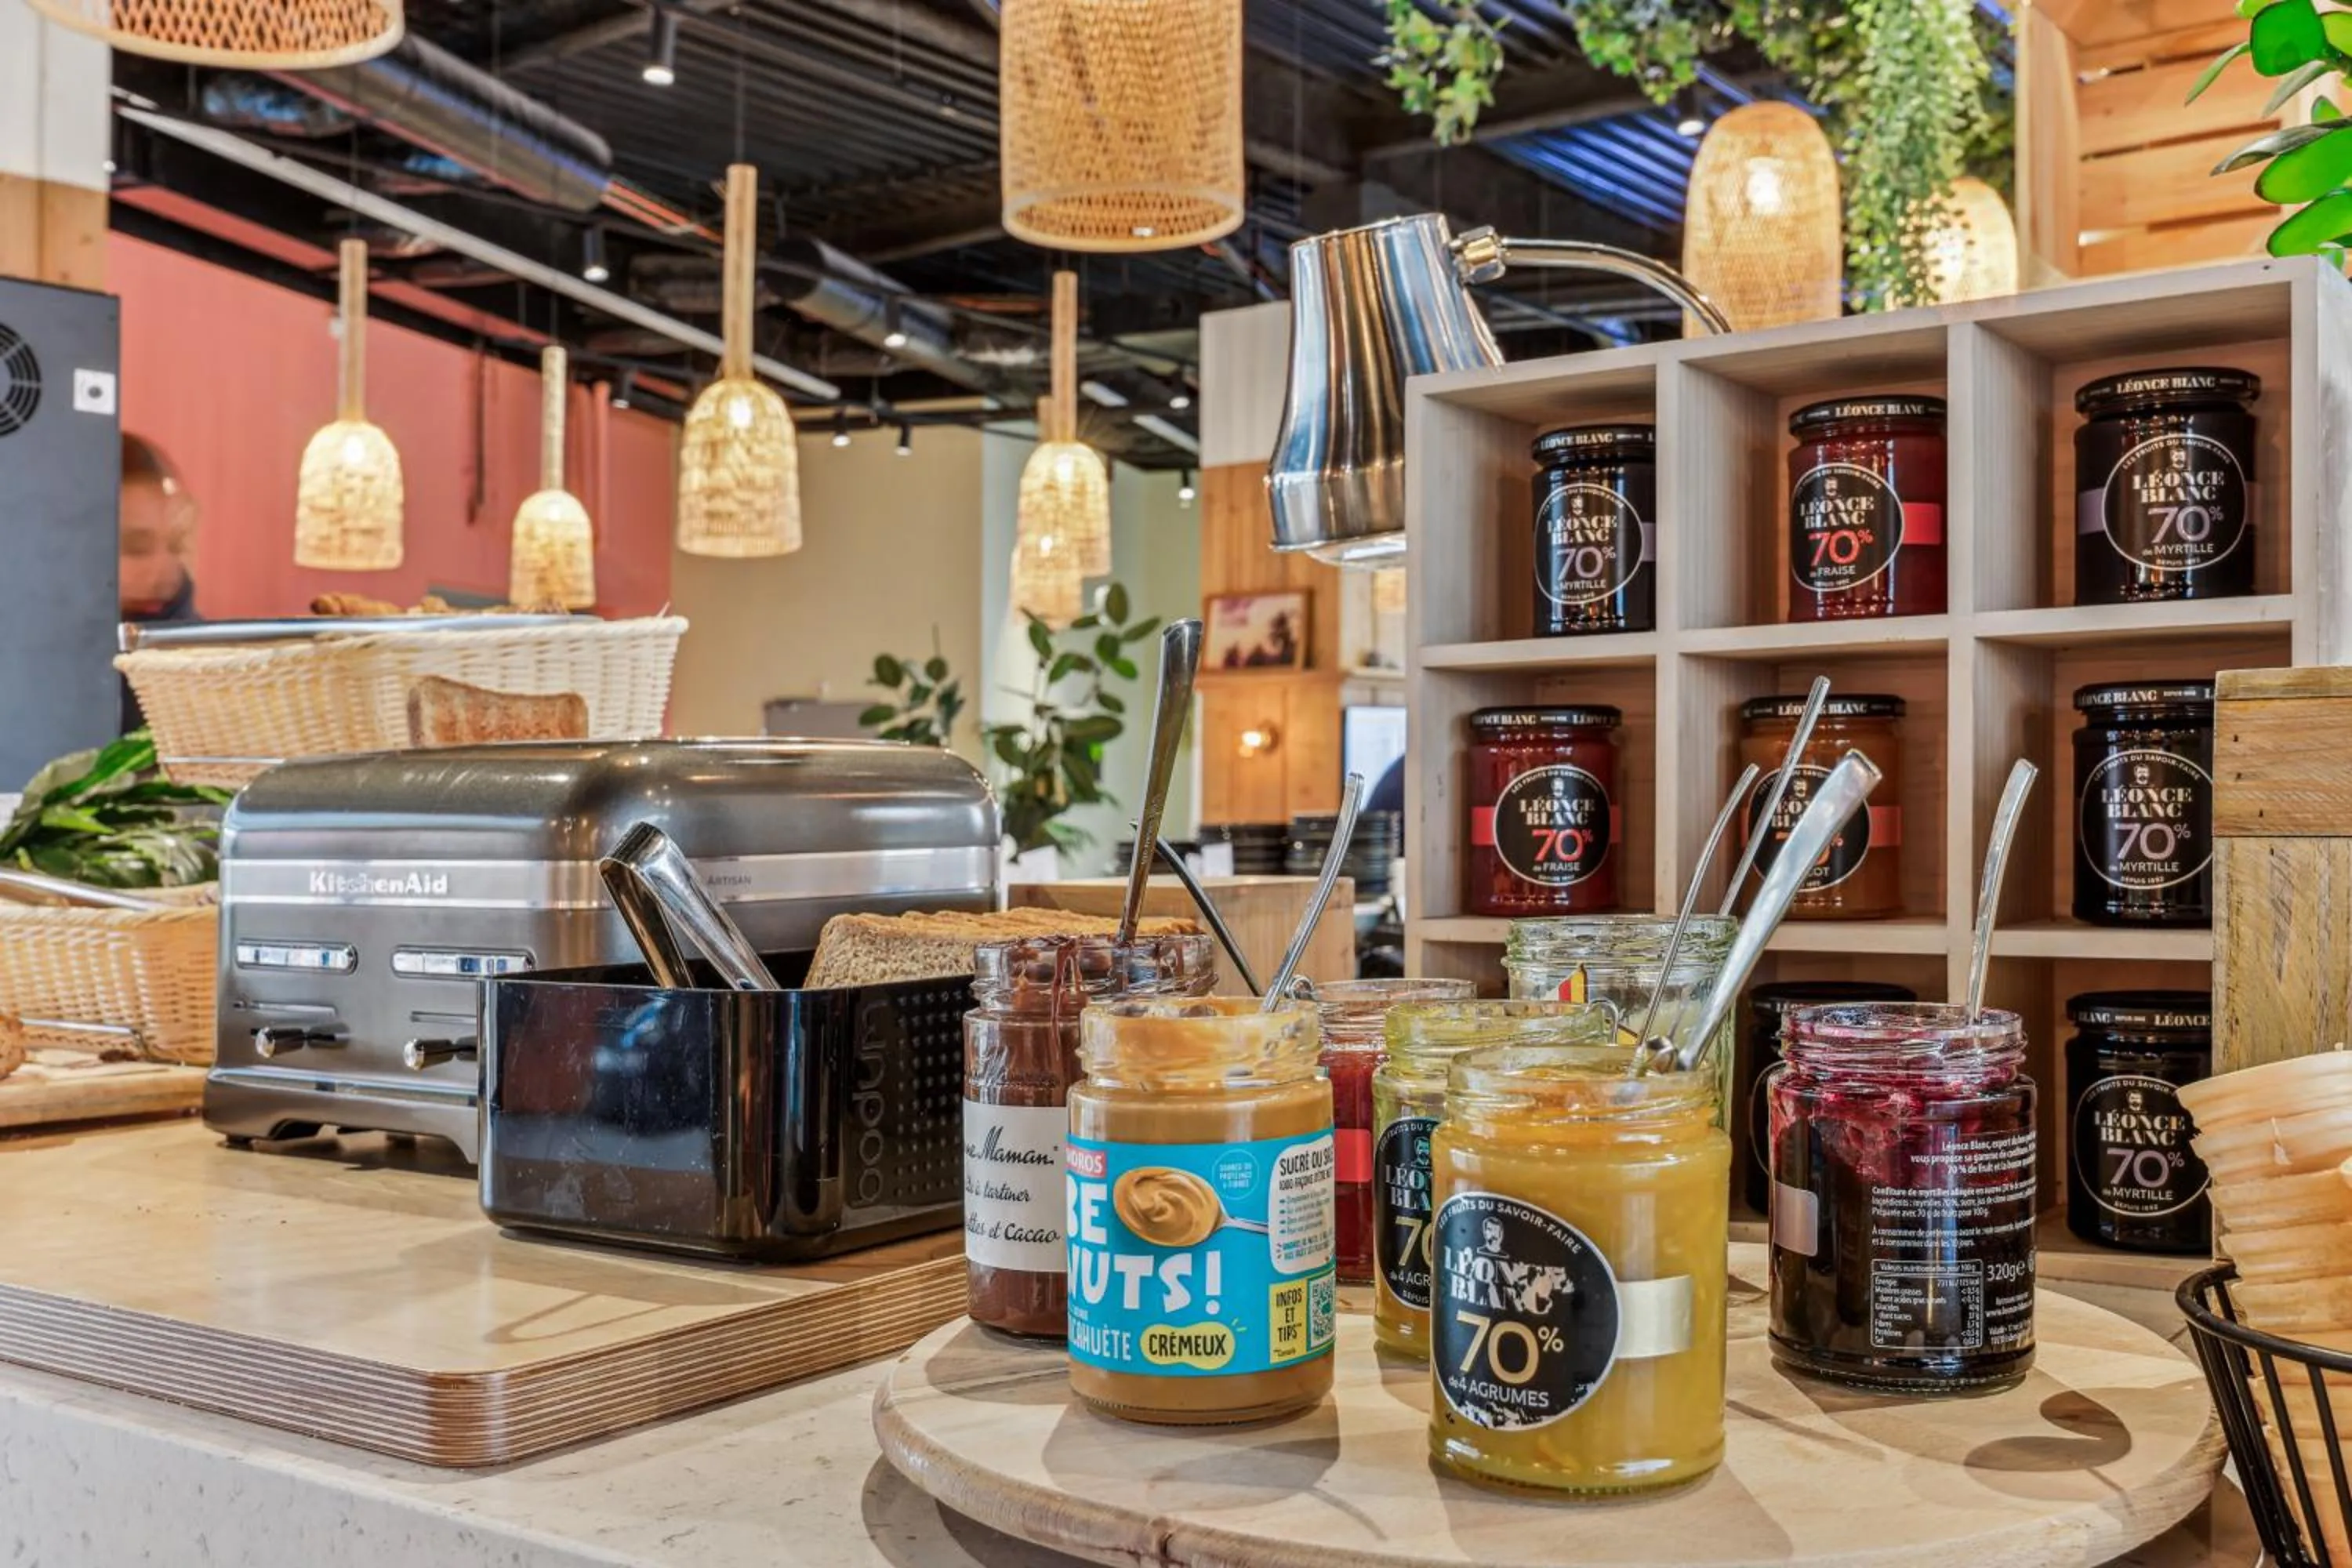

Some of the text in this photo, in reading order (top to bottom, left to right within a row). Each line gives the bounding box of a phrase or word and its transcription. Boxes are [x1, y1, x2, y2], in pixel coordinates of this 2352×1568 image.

[2117, 377, 2169, 394] LÉONCE
[2172, 376, 2216, 389] BLANC
[1835, 404, 1926, 418] LÉONCE BLANC
[1576, 432, 1613, 444] BLANC
[2132, 470, 2224, 490] LÉONCE
[2140, 487, 2216, 503] BLANC
[1799, 495, 1875, 516] LÉONCE
[1547, 514, 1618, 534] LÉONCE
[1805, 511, 1866, 529] BLANC
[2147, 505, 2224, 543] 70%
[1552, 528, 1610, 545] BLANC
[1808, 528, 1875, 567] 70%
[2154, 543, 2214, 555] MYRTILLE
[1556, 546, 1617, 581] 70%
[1817, 564, 1857, 577] FRAISE
[1559, 579, 1606, 590] MYRTILLE
[2113, 689, 2157, 702] BLANC
[1777, 702, 1826, 716] LÉOE
[1828, 702, 1867, 714] BLANC
[1501, 714, 1537, 724] BLANC
[2101, 784, 2193, 804] LÉONCE
[1519, 795, 1596, 813] LÉONCE
[2107, 803, 2182, 818] BLANC
[1526, 811, 1589, 826] BLANC
[1530, 828, 1594, 862] 70%
[2114, 823, 2192, 860] 70%
[1542, 861, 1581, 872] FRAISE
[2119, 862, 2180, 873] MYRTILLE
[309, 871, 448, 894] KitchenAid
[2154, 1011, 2211, 1027] LÉONCE
[851, 1000, 887, 1208] bodum
[1411, 1123, 1423, 1131] DU
[2094, 1109, 2186, 1131] LÉONCE
[979, 1125, 1054, 1166] Maman
[2100, 1127, 2176, 1146] BLANC
[1066, 1149, 1103, 1174] NDROS
[1279, 1150, 1309, 1177] SUCRÉ
[1910, 1154, 1929, 1163] vous
[1932, 1153, 1963, 1165] propose
[2107, 1147, 2186, 1189] 70%
[1968, 1164, 1977, 1174] de
[983, 1180, 1029, 1202] tartiner
[1872, 1186, 1907, 1196] Confiture
[2112, 1187, 2174, 1200] MYRTILLE
[989, 1220, 1002, 1240] et
[1004, 1222, 1060, 1243] Cacao
[1478, 1200, 1494, 1211] DU
[1497, 1200, 1582, 1254] SAVOIR-FAIRE
[1276, 1287, 1302, 1308] INFOS
[1285, 1307, 1295, 1323] ET
[1148, 1330, 1227, 1357] CRÉMEUX
[1456, 1309, 1564, 1385] 70%
[1457, 1376, 1467, 1391] 4
[1468, 1379, 1550, 1408] AGRUMES
